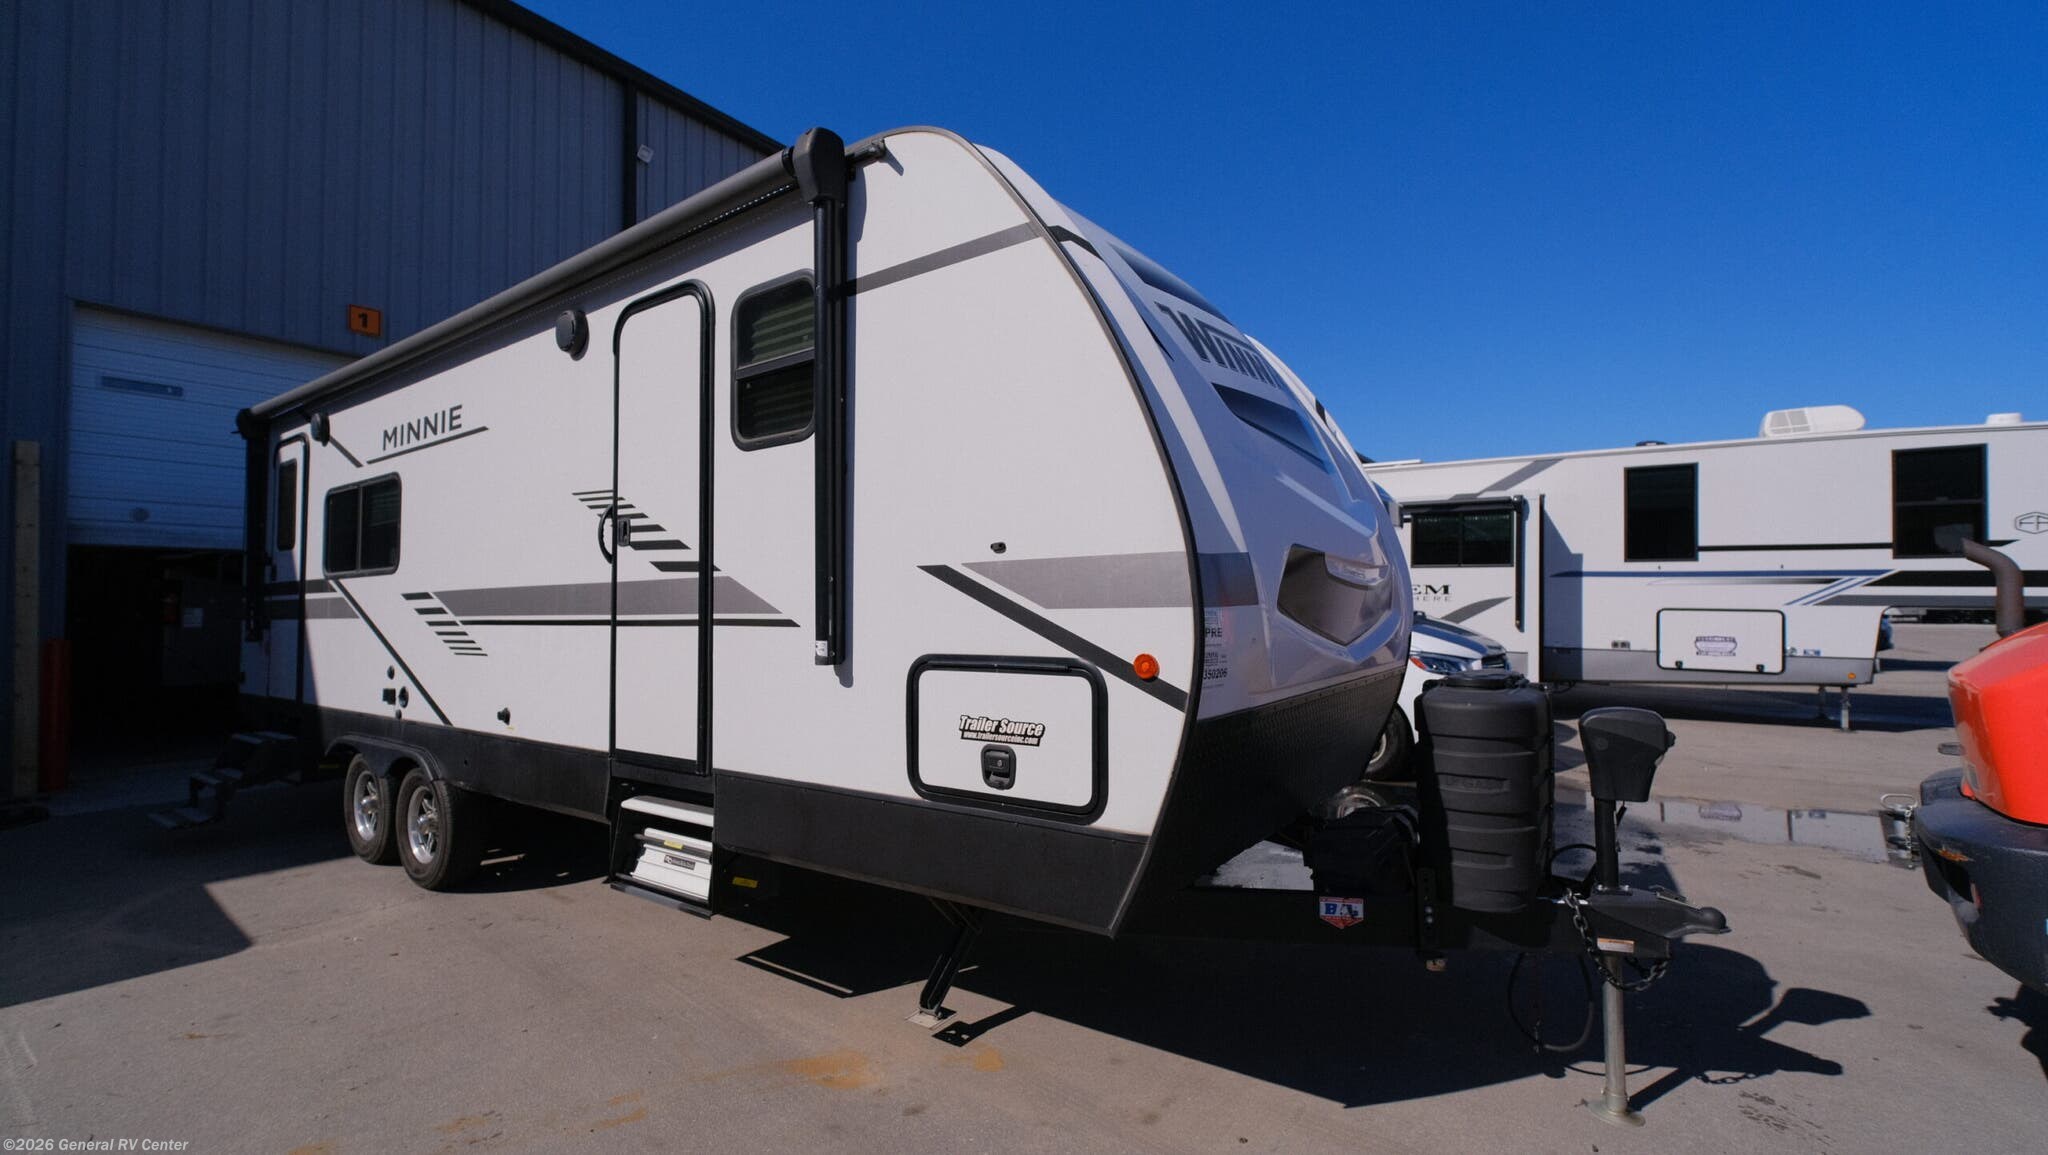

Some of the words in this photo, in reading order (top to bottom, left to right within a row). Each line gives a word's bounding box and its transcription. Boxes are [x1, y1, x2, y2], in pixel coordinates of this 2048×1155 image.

[358, 313, 368, 328] 1
[1154, 301, 1281, 389] WINN
[382, 405, 462, 451] MINNIE
[960, 715, 999, 733] Trailer
[999, 718, 1043, 737] Source
